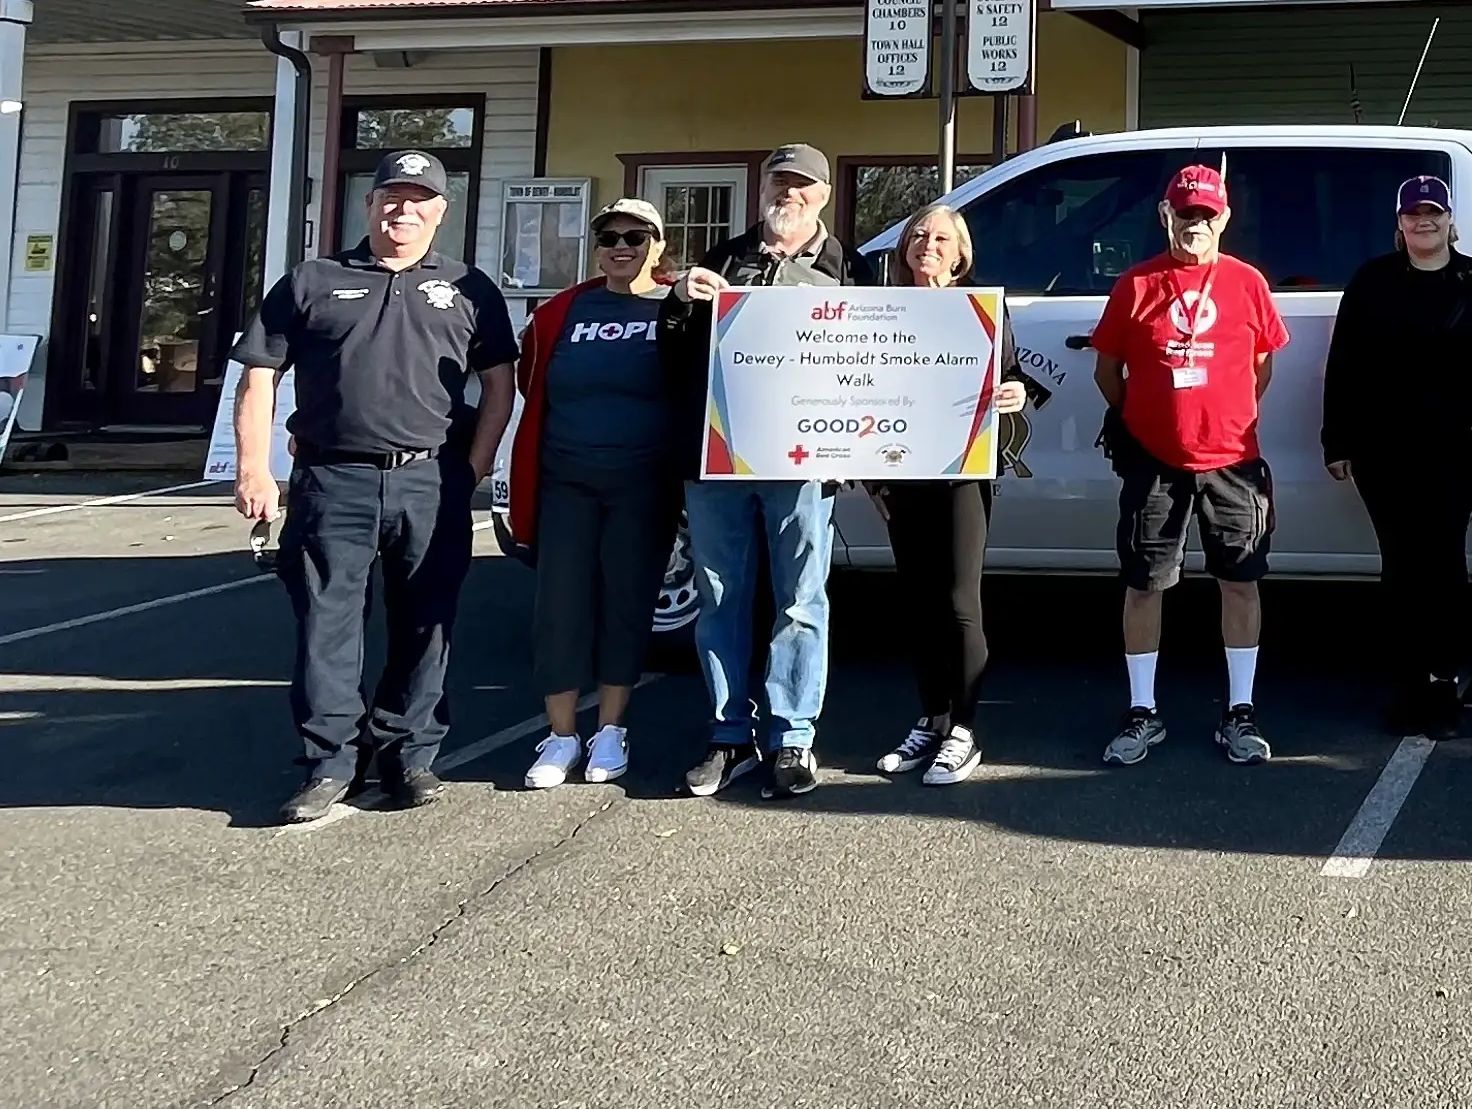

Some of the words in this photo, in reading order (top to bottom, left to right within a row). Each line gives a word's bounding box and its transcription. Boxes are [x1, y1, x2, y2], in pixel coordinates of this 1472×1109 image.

[872, 7, 926, 19] CHAMBERS
[976, 4, 984, 15] &
[987, 3, 1024, 15] SAFETY
[889, 20, 907, 31] 10
[991, 16, 1008, 27] 12
[871, 39, 899, 51] TOWN
[901, 38, 925, 50] HALL
[982, 35, 1017, 47] PUBLIC
[877, 52, 918, 64] OFFICES
[982, 48, 1018, 60] WORKS
[888, 65, 905, 76] 12
[990, 61, 1007, 72] 12
[811, 300, 848, 321] abf
[848, 304, 884, 312] Arizona
[886, 304, 907, 312] Burn
[847, 312, 898, 322] Foundation
[795, 329, 869, 344] Welcome
[873, 331, 889, 344] to
[893, 330, 917, 345] the
[733, 351, 785, 369] Dewey
[800, 351, 876, 366] Humboldt
[879, 350, 931, 366] Smoke
[934, 350, 979, 366] Alarm
[836, 372, 875, 388] Walk
[791, 395, 847, 408] Generously
[849, 395, 900, 408] Sponsored
[797, 414, 908, 439] GOOD2GO
